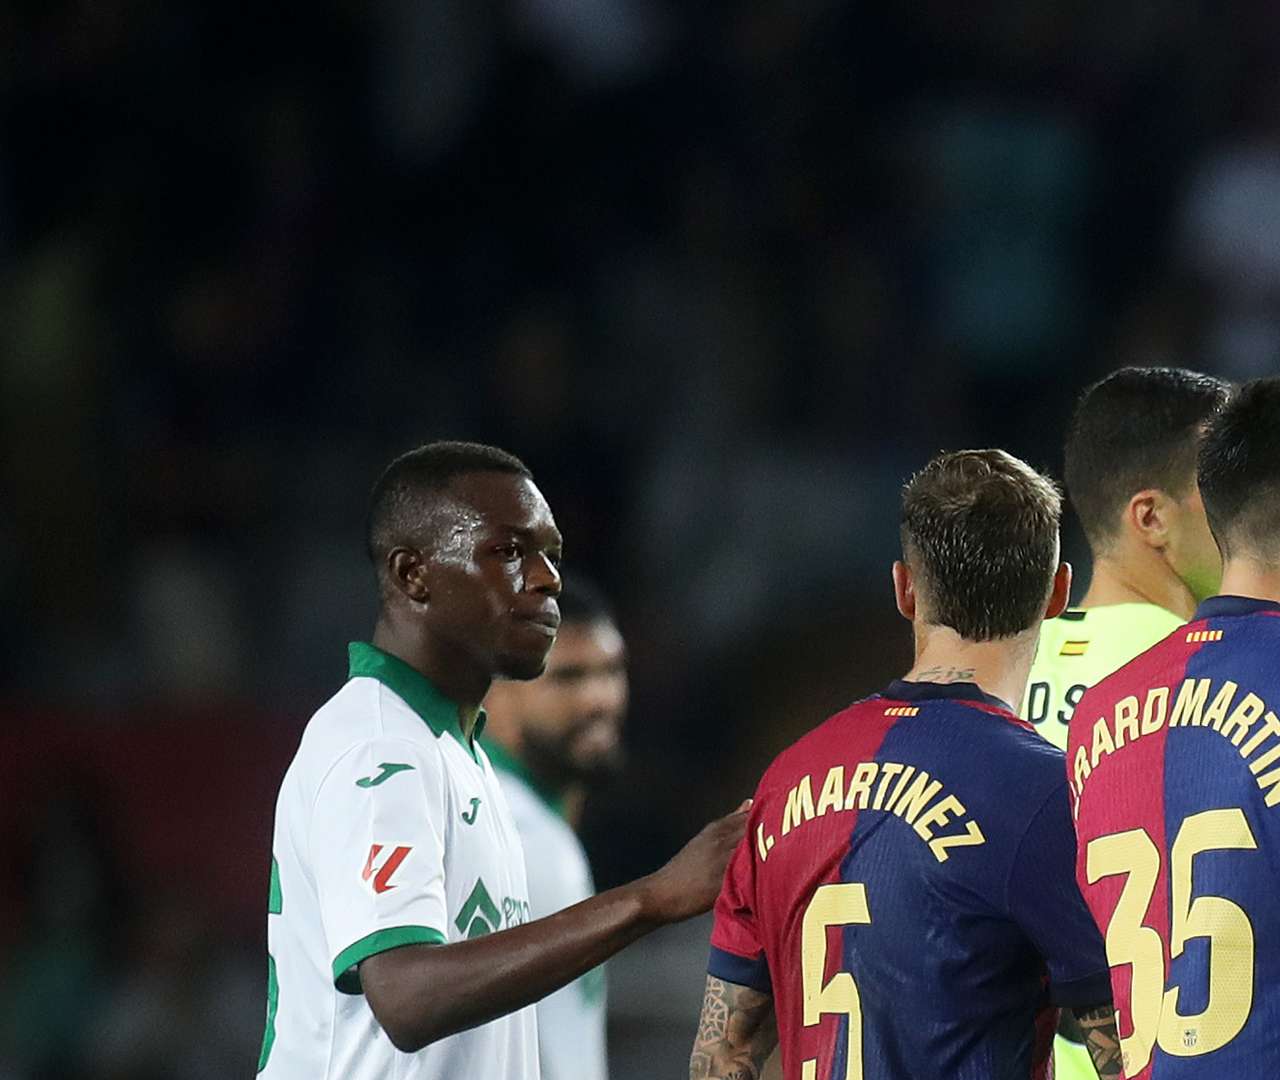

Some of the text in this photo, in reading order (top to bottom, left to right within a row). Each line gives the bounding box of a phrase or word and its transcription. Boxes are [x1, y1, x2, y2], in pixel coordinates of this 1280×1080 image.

[782, 762, 986, 863] MARTINEZ
[1070, 686, 1169, 820] RARD
[1086, 808, 1257, 1079] 35
